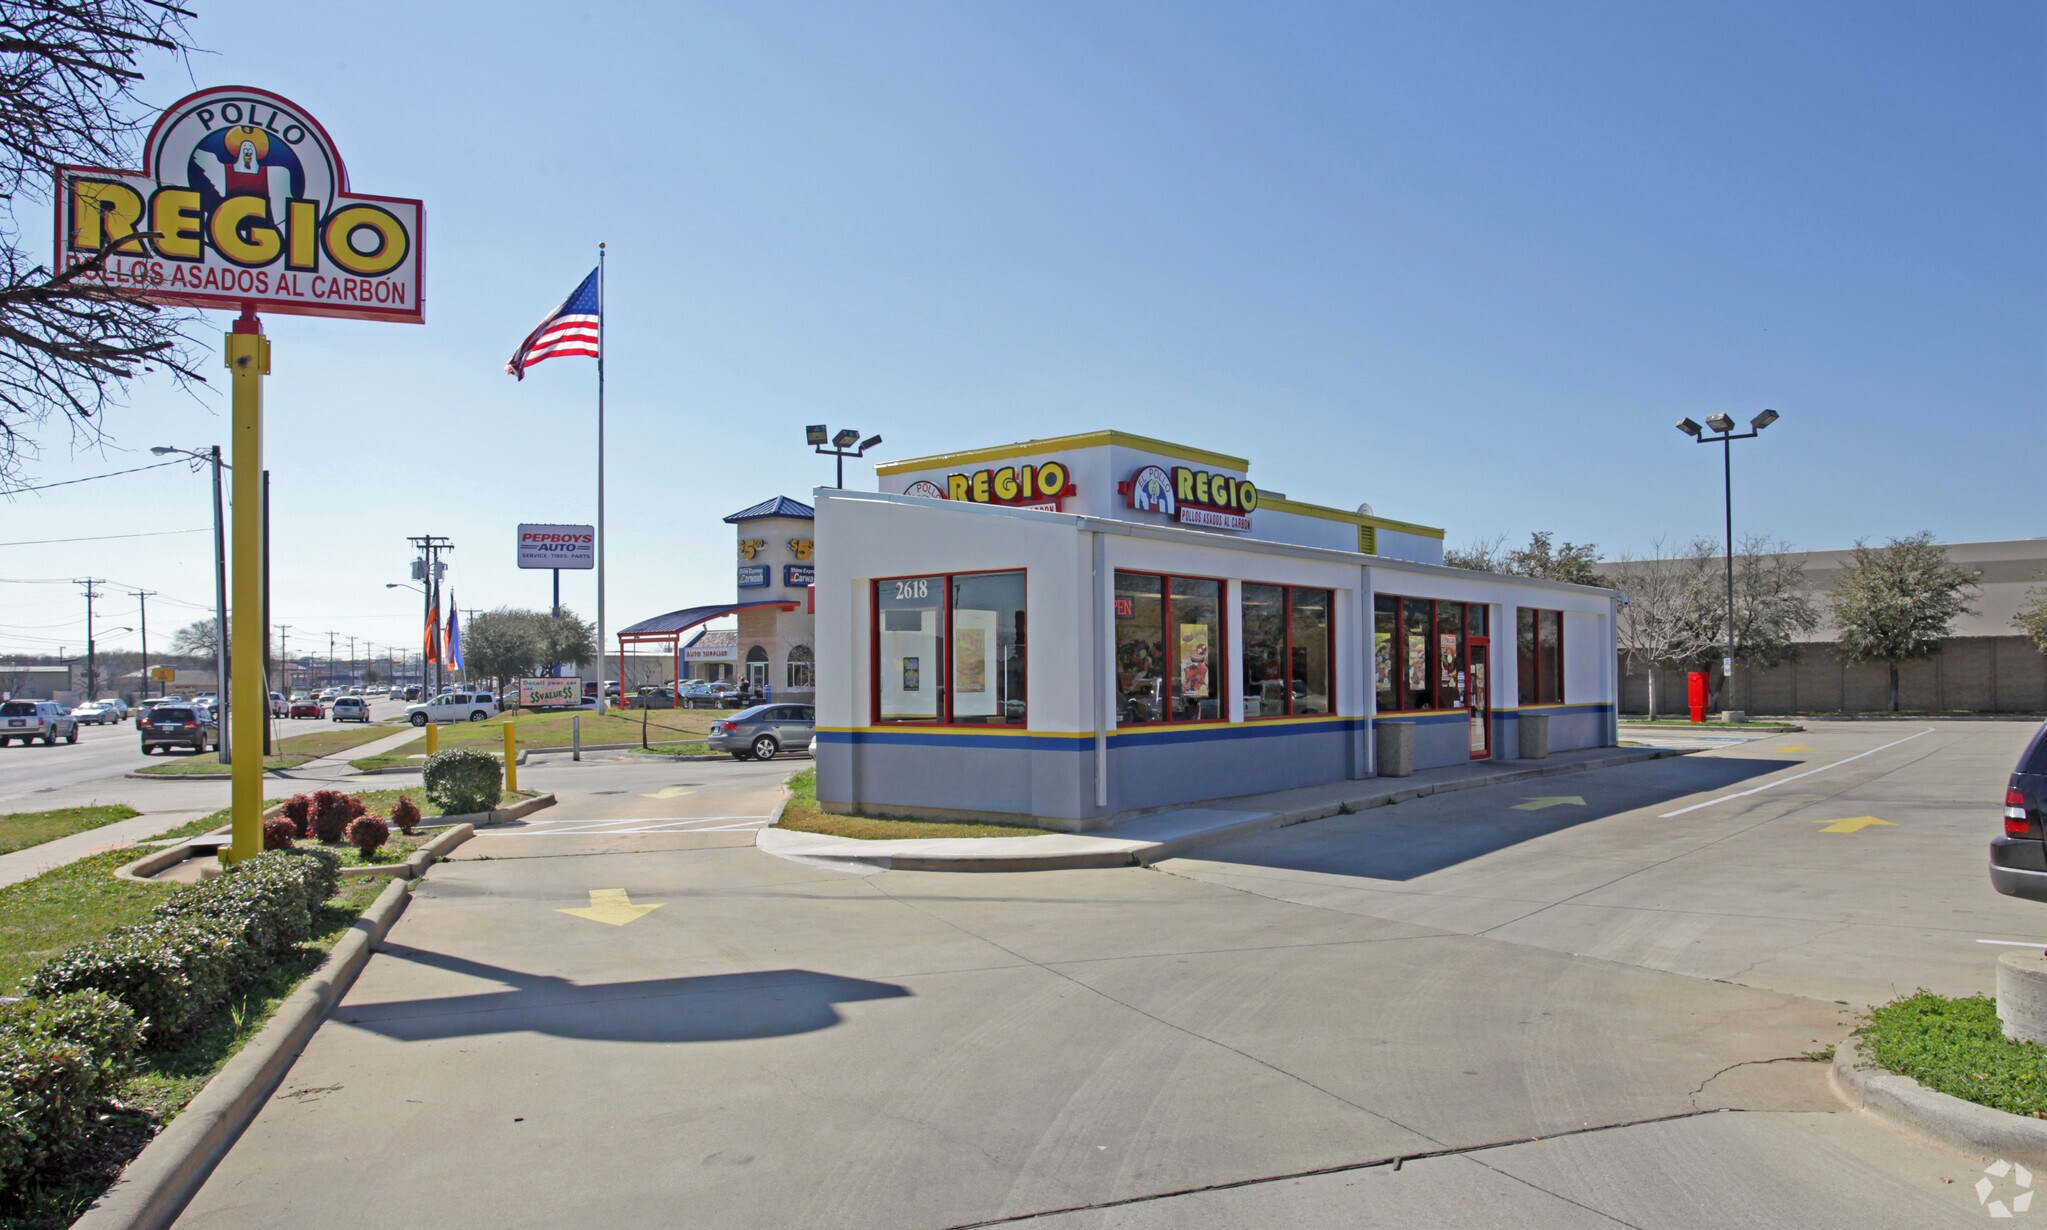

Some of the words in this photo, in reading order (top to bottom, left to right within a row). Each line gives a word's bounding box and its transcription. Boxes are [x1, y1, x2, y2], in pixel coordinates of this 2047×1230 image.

[197, 103, 306, 146] POLLO
[68, 175, 411, 278] REGIO
[172, 264, 270, 294] ASADOS
[275, 272, 304, 297] AL
[312, 276, 406, 305] CARBÓN
[947, 461, 1065, 503] REGIO
[1149, 468, 1171, 493] POLLO
[1176, 466, 1258, 513] REGIO
[1182, 509, 1201, 523] POLLOS
[1203, 513, 1222, 526] ASADOS
[1224, 516, 1230, 527] AL
[521, 533, 592, 543] PEPBOYS
[538, 543, 577, 551] AUTO
[896, 579, 928, 600] 2618
